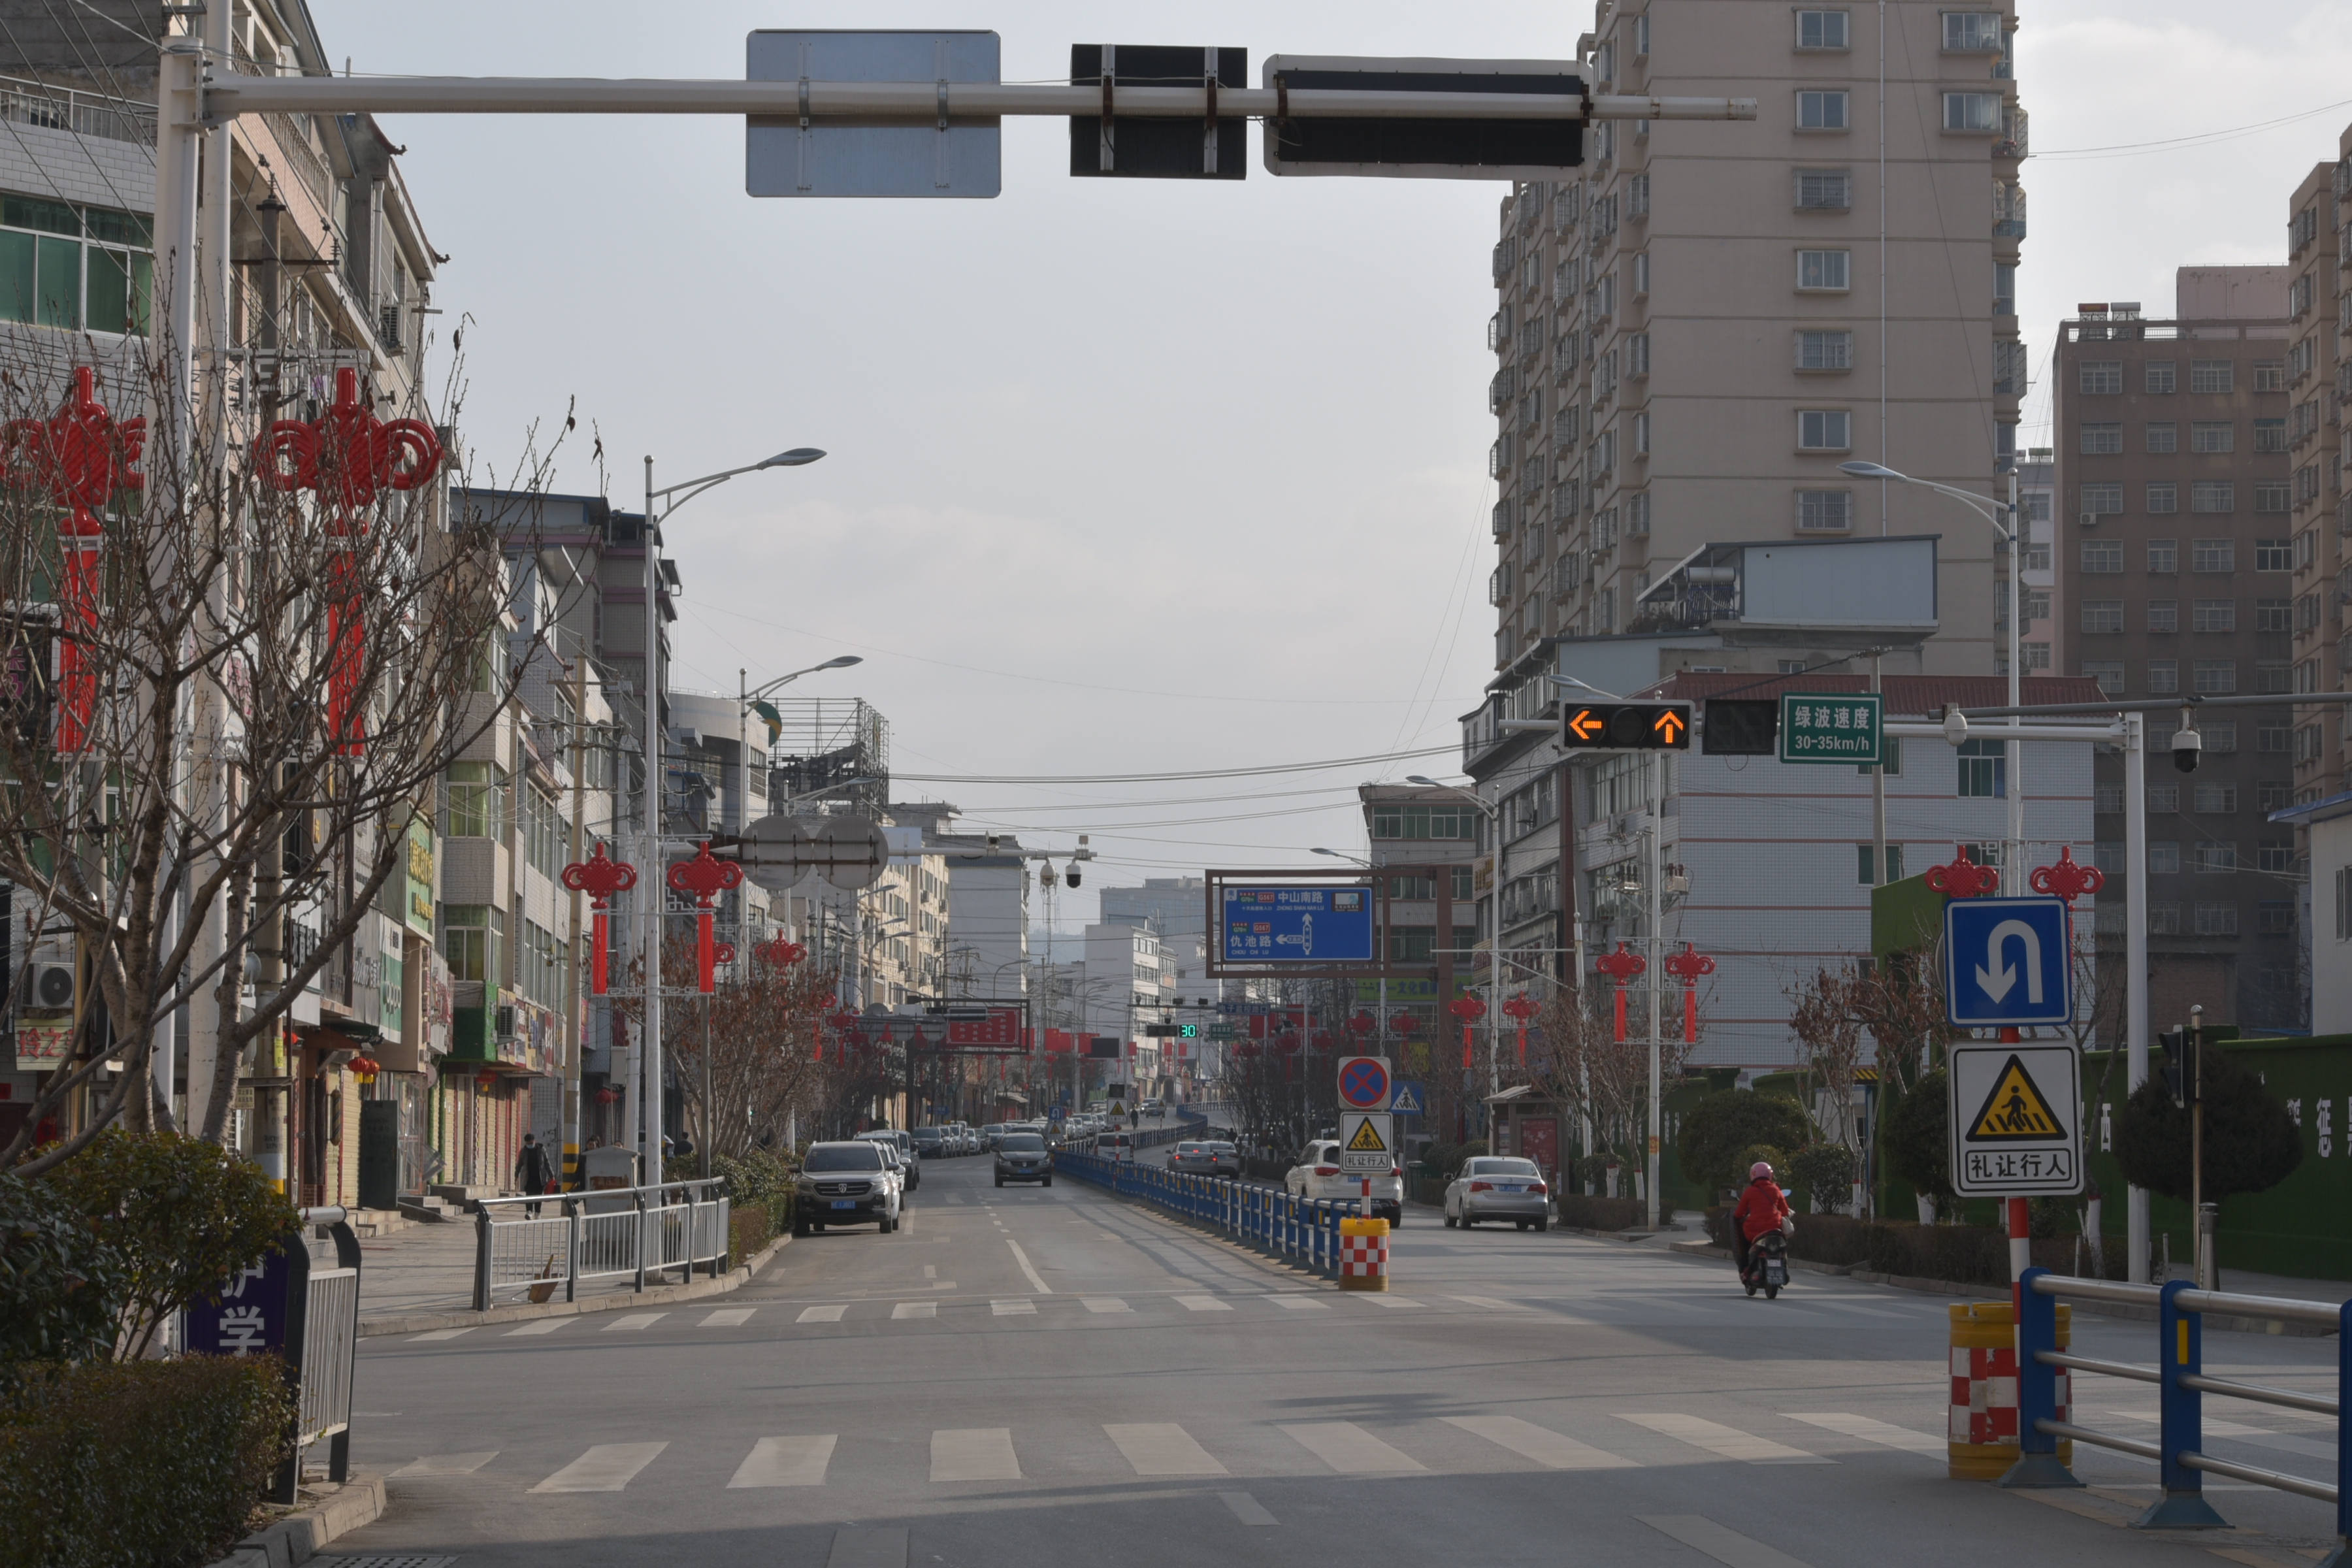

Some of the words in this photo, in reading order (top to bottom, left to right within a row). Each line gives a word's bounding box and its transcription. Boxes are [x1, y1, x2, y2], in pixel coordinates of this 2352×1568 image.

[1795, 706, 1869, 729] 绿波速度
[1795, 734, 1870, 752] 30-35km/h
[1278, 891, 1324, 904] 中山南路
[1230, 935, 1271, 947] 仇池路
[1218, 1004, 1268, 1013] 电子监控路口
[1181, 1024, 1196, 1037] 30
[1347, 1156, 1386, 1166] 礼让行人
[1970, 1154, 2066, 1179] 礼让行人
